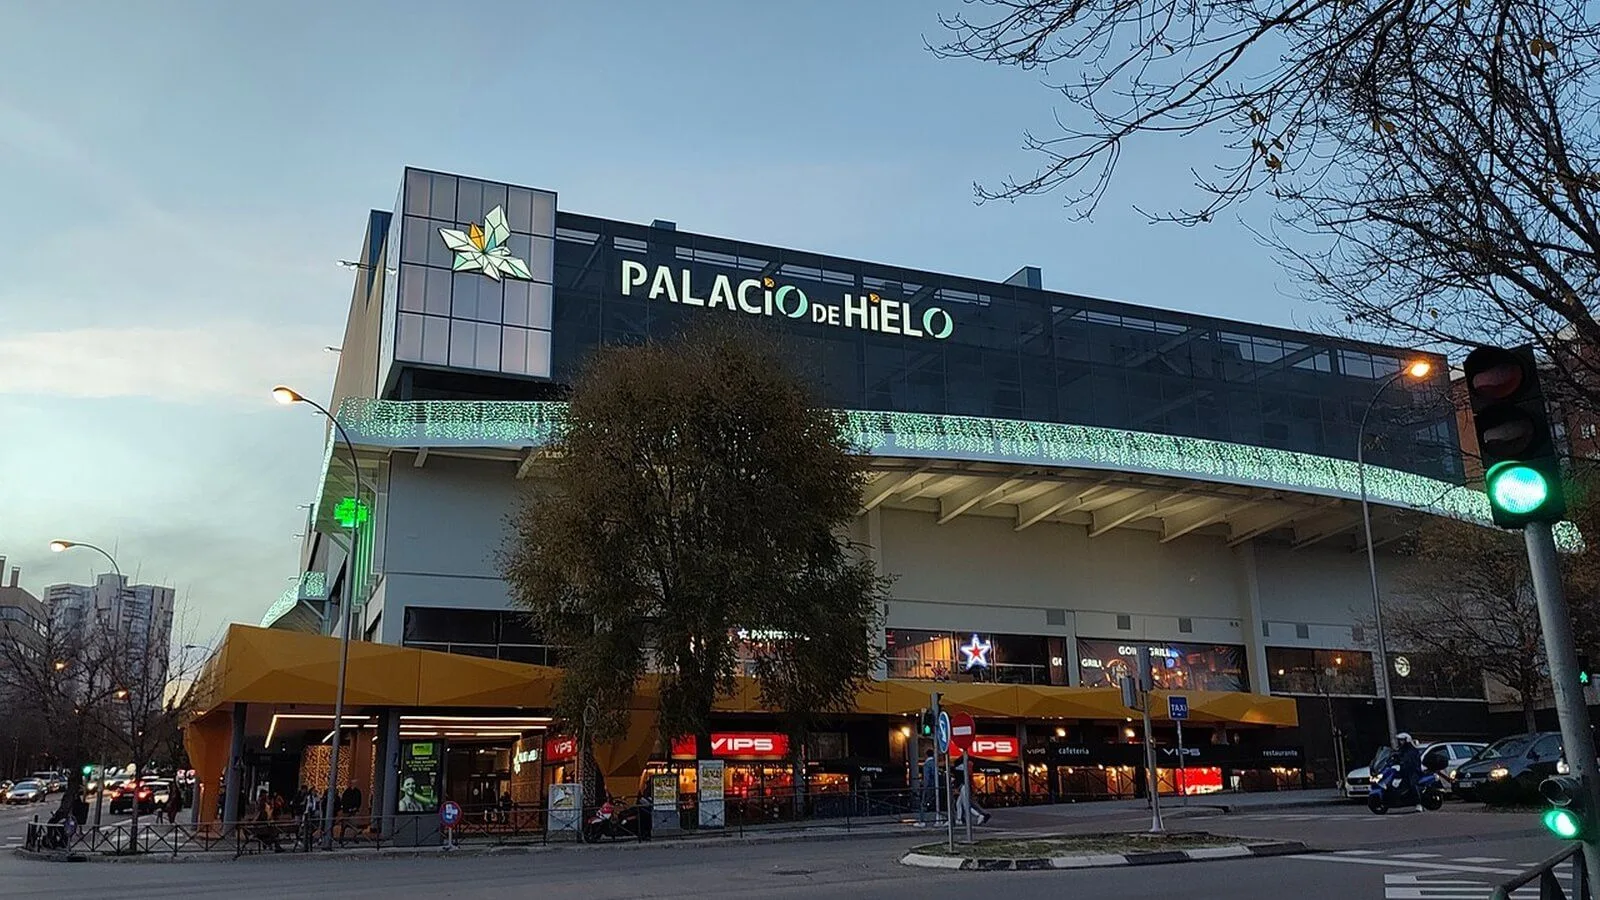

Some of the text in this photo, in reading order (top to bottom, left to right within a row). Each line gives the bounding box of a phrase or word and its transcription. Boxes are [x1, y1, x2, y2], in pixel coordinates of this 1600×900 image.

[812, 302, 840, 327] DE
[1171, 703, 1187, 712] TAXI
[711, 738, 773, 750] VIPS
[971, 740, 1013, 753] IPS
[1058, 746, 1090, 755] cafeteria
[1163, 748, 1200, 757] VIPS
